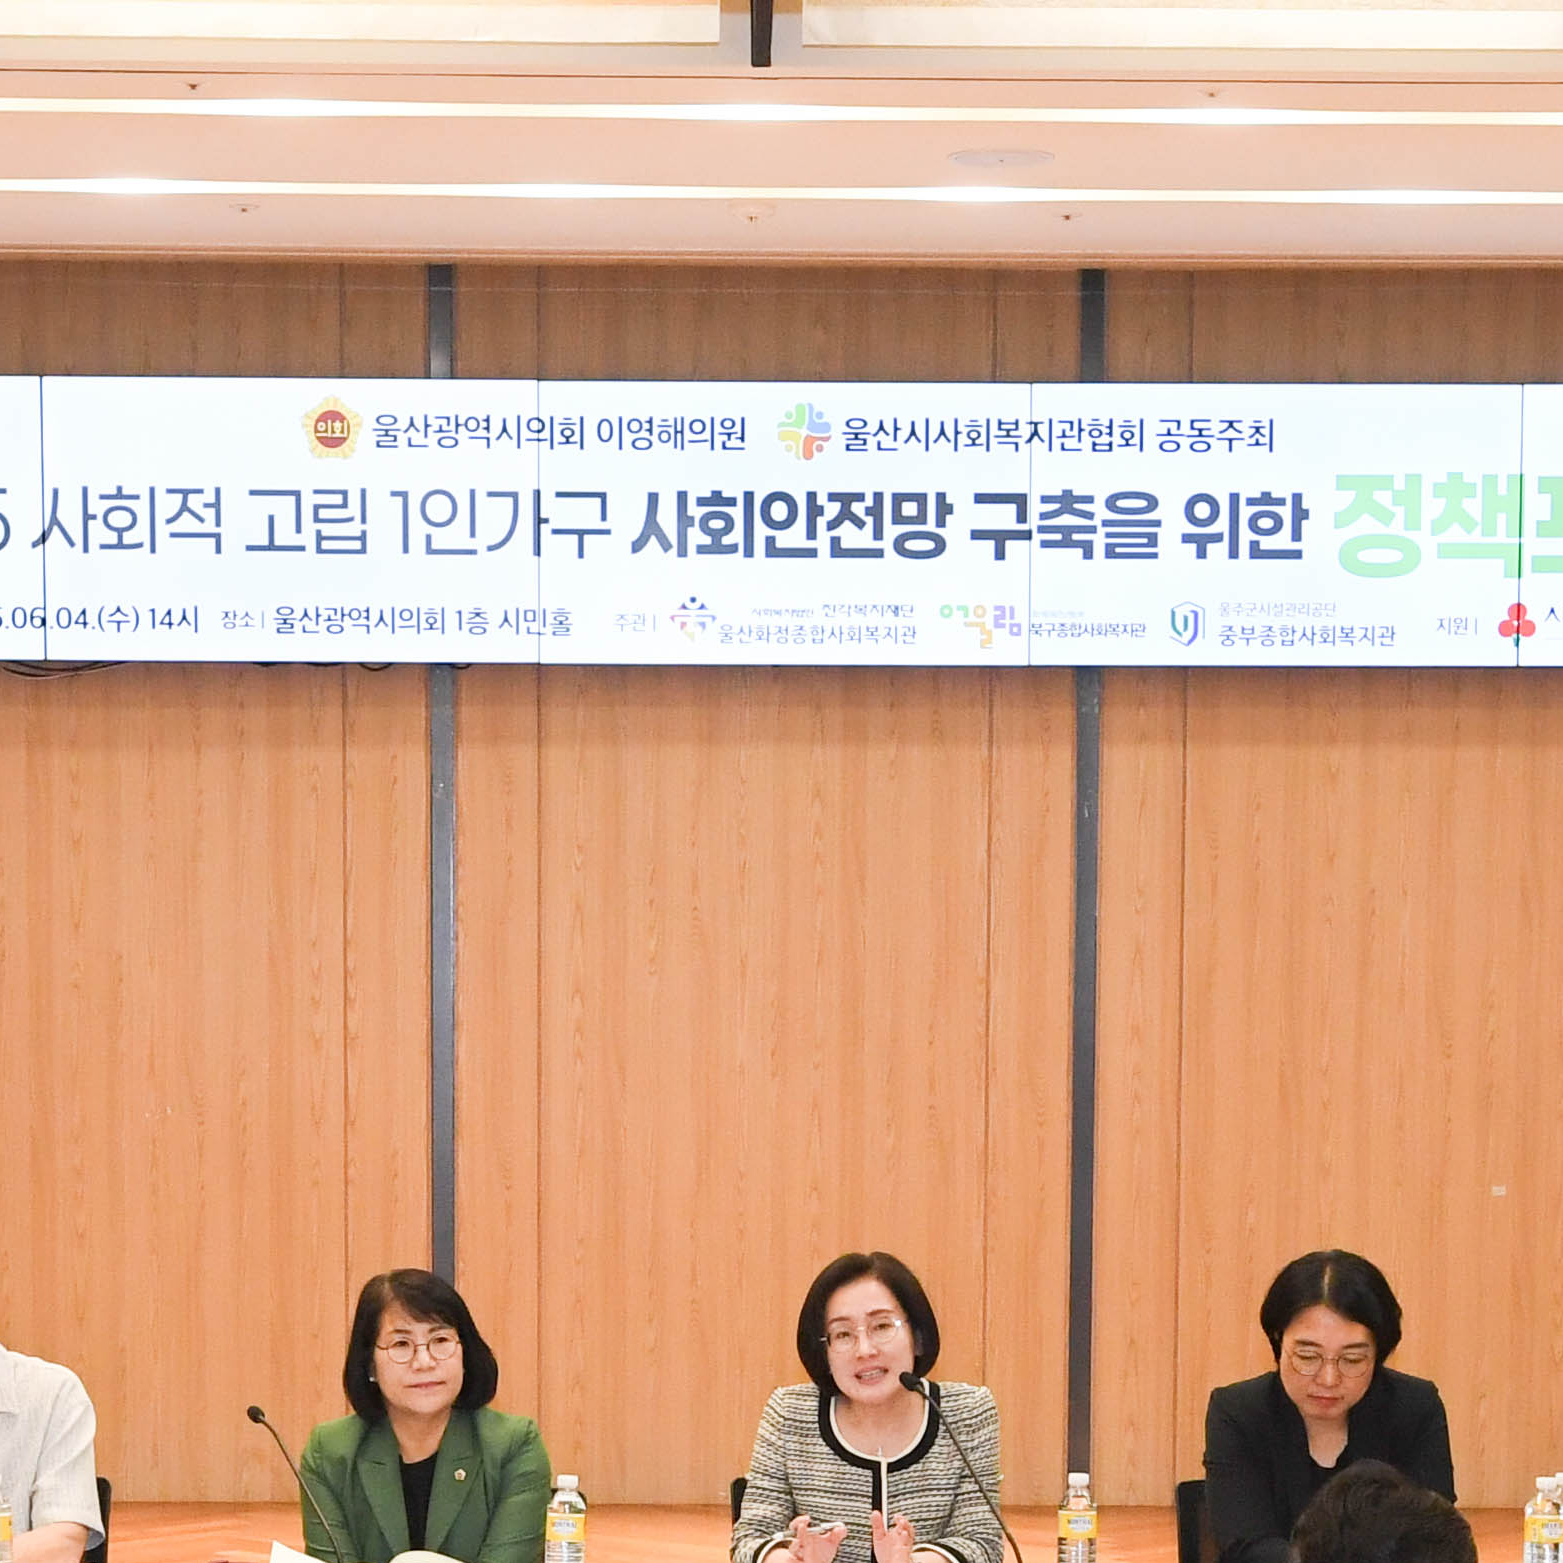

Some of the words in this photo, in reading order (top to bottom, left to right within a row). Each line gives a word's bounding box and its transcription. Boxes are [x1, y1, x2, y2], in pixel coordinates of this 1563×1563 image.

[315, 419, 349, 438] 의회
[371, 413, 585, 451] 울산광역시의회
[596, 415, 747, 452] 이영해의원
[840, 416, 1145, 454] 울산시사회복지관협회
[1155, 418, 1275, 454] 공동주최
[30, 484, 223, 555] 사회적
[244, 487, 368, 556] 고립
[388, 487, 613, 560] 1인가구
[630, 489, 955, 561] 사회안전망
[969, 488, 1163, 562] 구축을
[1180, 490, 1310, 561] 위한
[148, 607, 199, 631] 14시
[220, 610, 255, 630] 장소
[272, 605, 446, 635] 울산광역시의회
[454, 607, 490, 636] 1층
[497, 607, 574, 637] 시민홀
[613, 613, 647, 633] 주관
[1436, 617, 1468, 635] 지원
[719, 624, 917, 645] 울산화정종합사회복지관
[1218, 624, 1396, 647] 중부종합사회복지관
